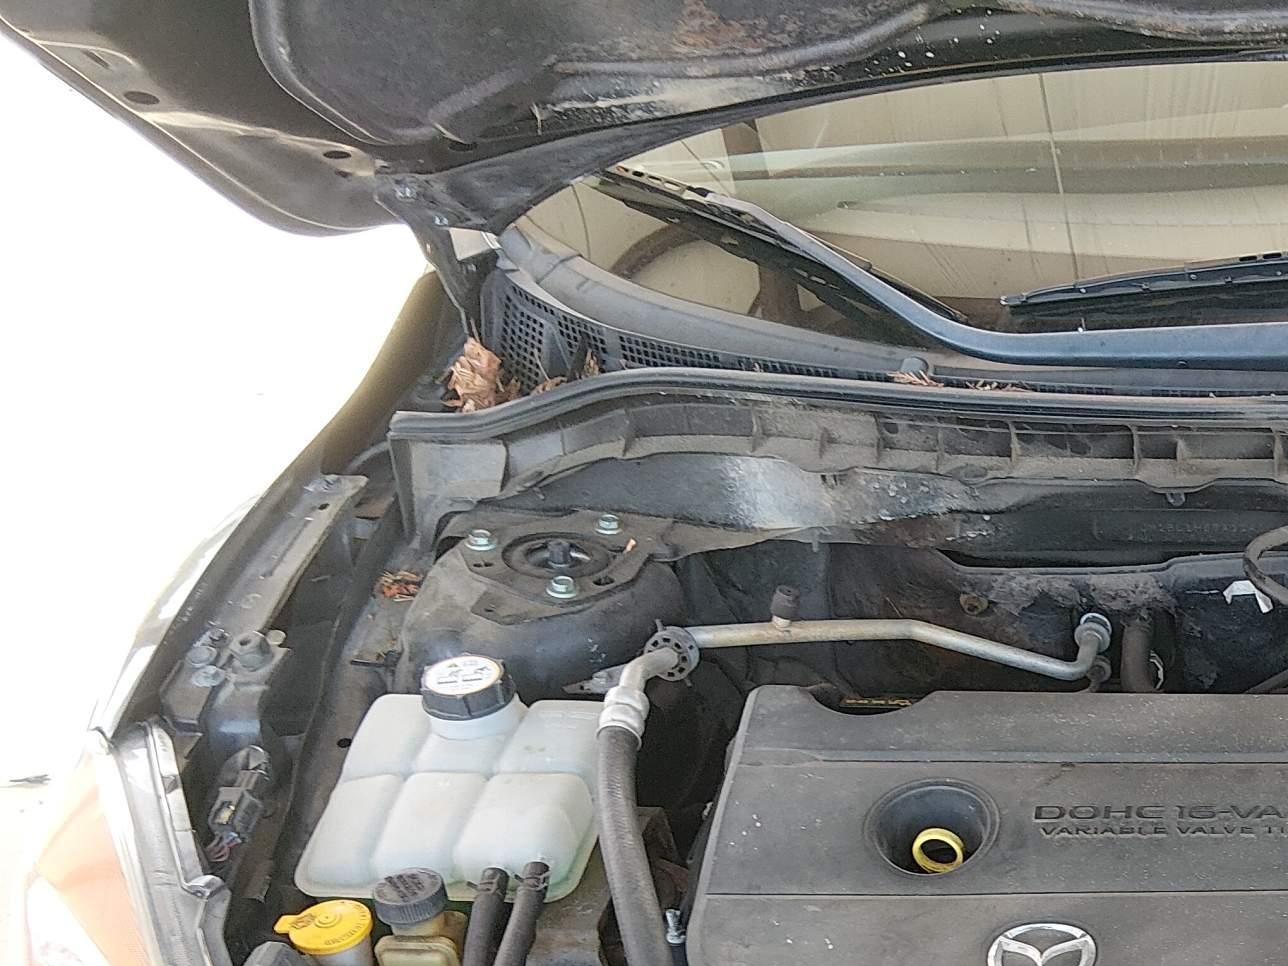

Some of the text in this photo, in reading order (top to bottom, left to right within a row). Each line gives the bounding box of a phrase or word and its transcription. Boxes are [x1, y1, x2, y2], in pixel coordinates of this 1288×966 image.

[1034, 805, 1166, 820] DOHC
[1041, 825, 1169, 837] VARIABLE
[1176, 825, 1256, 836] VALVE
